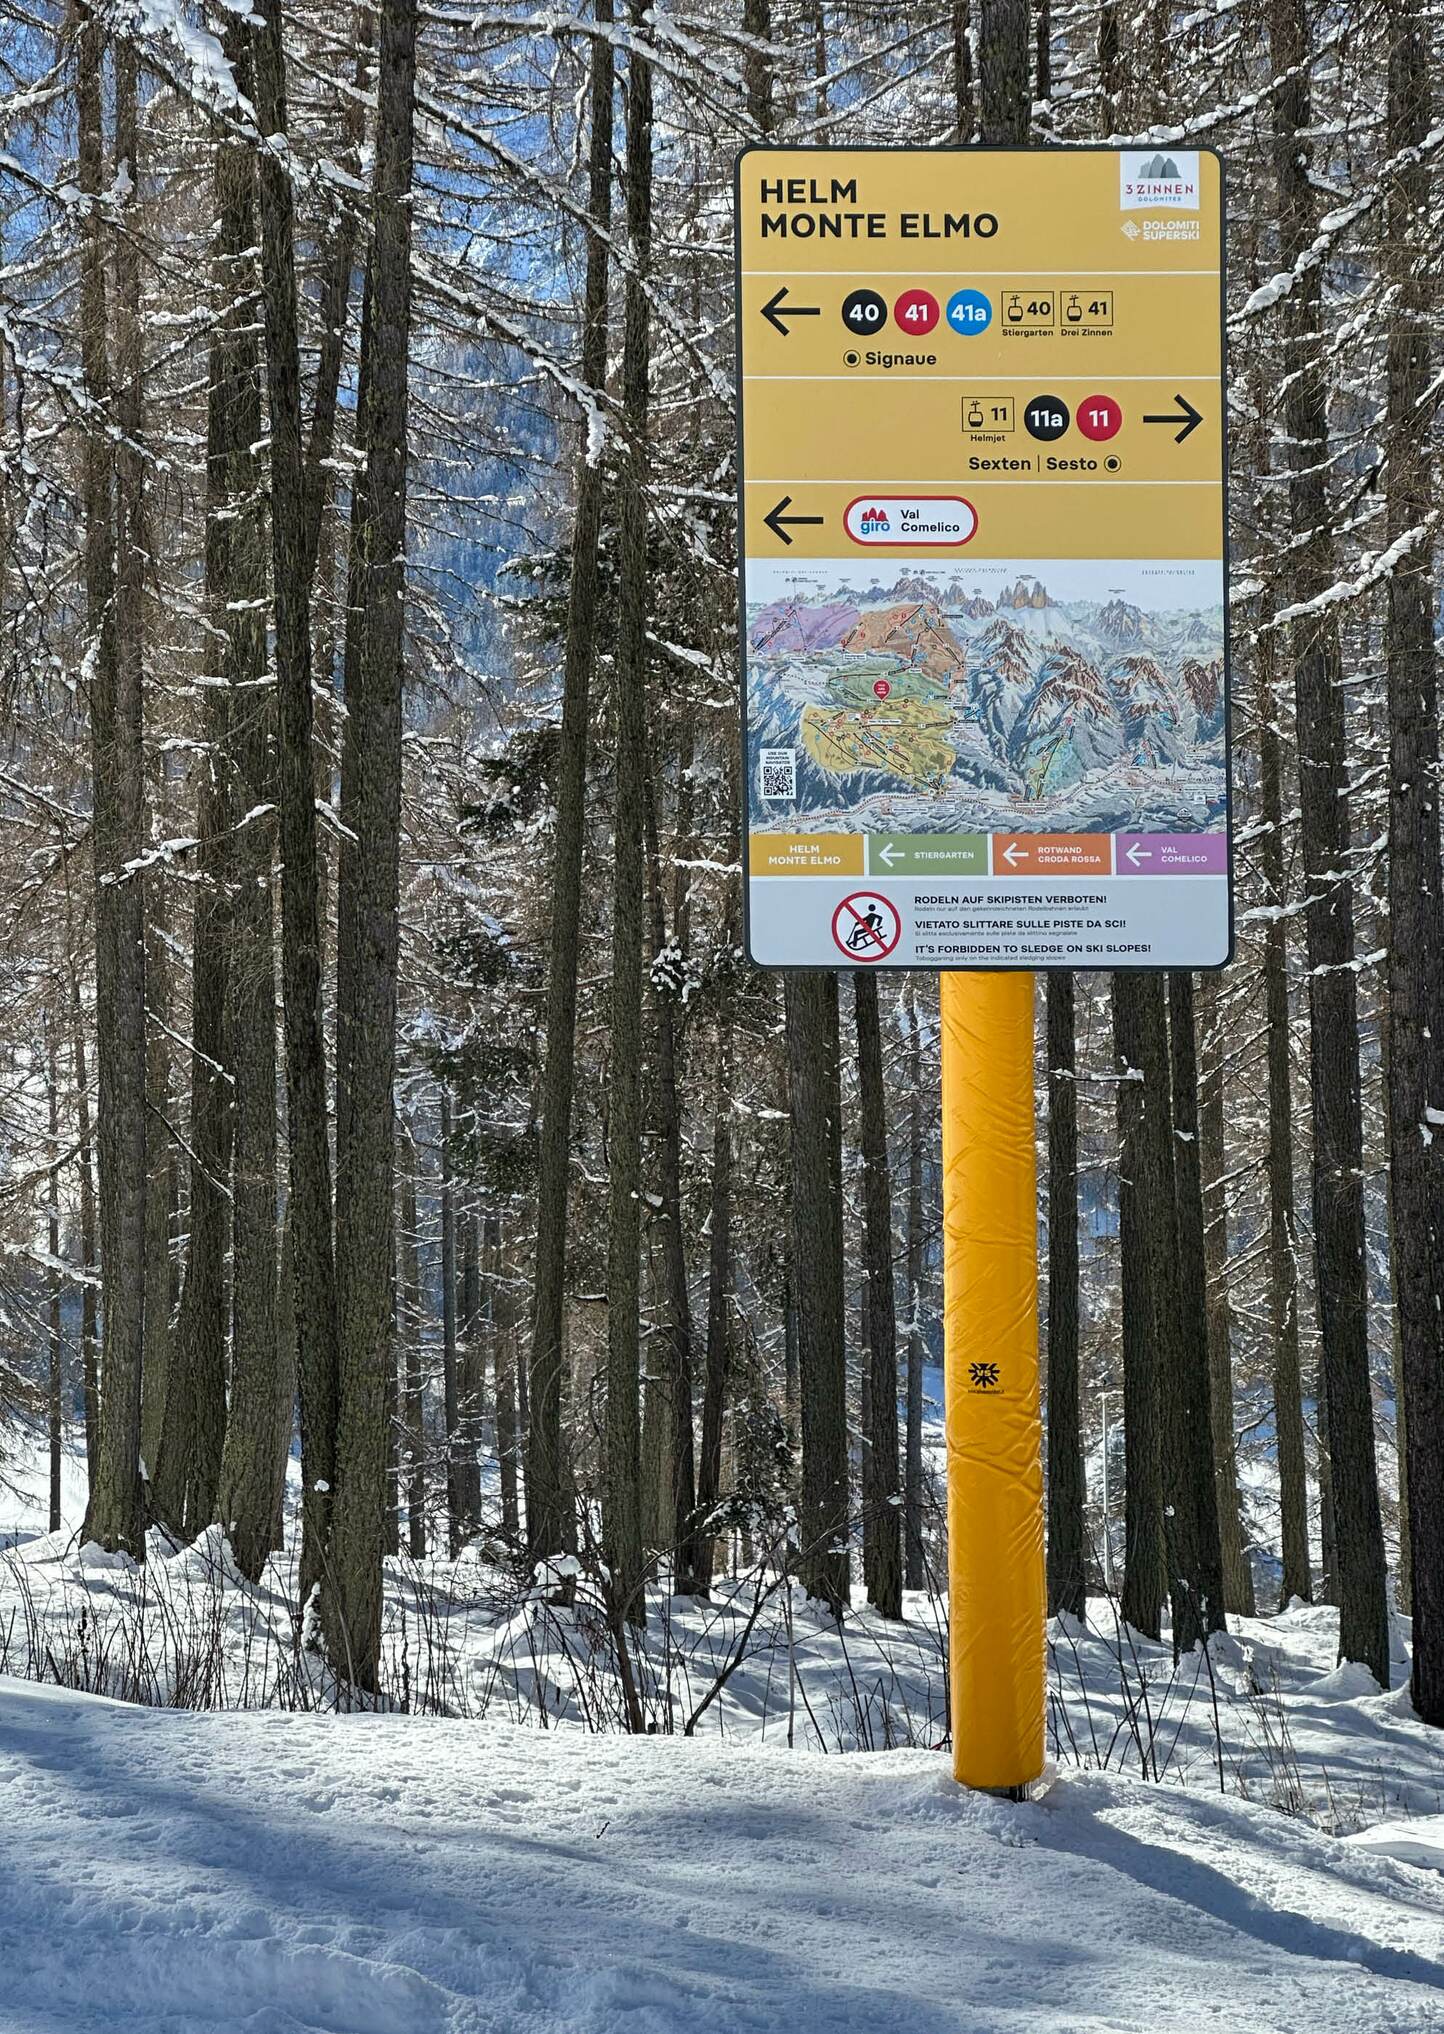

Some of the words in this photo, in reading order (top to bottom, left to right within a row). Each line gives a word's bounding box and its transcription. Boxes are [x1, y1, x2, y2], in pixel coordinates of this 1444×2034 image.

[761, 179, 857, 204] HELM
[761, 213, 886, 238] MONTE
[900, 213, 998, 238] ELMO
[1143, 221, 1199, 231] DOLOMITI
[1143, 230, 1199, 240] SUPERSKI
[849, 304, 879, 321] 40
[905, 304, 928, 321] 41
[951, 304, 986, 321] 41a
[1027, 301, 1051, 316] 40
[1088, 301, 1107, 316] 41
[1002, 328, 1054, 338] Stiergarten
[1060, 328, 1079, 336] Drei
[1081, 328, 1113, 336] Zinnen
[865, 351, 937, 368] Signaue
[991, 407, 1007, 421] 11
[1031, 410, 1063, 427] 11a
[1089, 410, 1108, 427] 11
[970, 434, 1006, 443] Helmjet
[969, 457, 1031, 470] Sexten
[1046, 457, 1097, 470] Sesto
[900, 509, 919, 519] Val
[860, 521, 890, 534] giro
[901, 522, 960, 532] Comelico
[789, 845, 820, 854] HELM
[1161, 846, 1178, 854] VAL
[914, 851, 974, 859] STIERGARTEN
[1038, 855, 1069, 863] CRODA
[1071, 855, 1101, 863] ROSSA
[1161, 855, 1208, 863] COMELICO
[768, 856, 807, 865] MONTE
[810, 856, 841, 865] ELMO
[914, 896, 959, 904] RODELN
[962, 896, 984, 904] AUF
[987, 896, 1042, 904] SKIPISTEN
[1045, 895, 1107, 904] VERBOTEN!
[915, 920, 960, 929] VIETATO
[963, 920, 1013, 928] SLITTARE
[1016, 920, 1050, 928] SULLE
[1053, 920, 1083, 928] PISTE
[1086, 920, 1102, 928] DA
[1104, 920, 1126, 928] SCI!
[915, 944, 935, 953] IT'S
[938, 945, 1000, 953] FORBIDDEN
[1003, 945, 1018, 953] TO
[1021, 945, 1063, 953] SLEDGE
[1066, 945, 1083, 953] ON
[1106, 944, 1151, 952] SLOPES!
